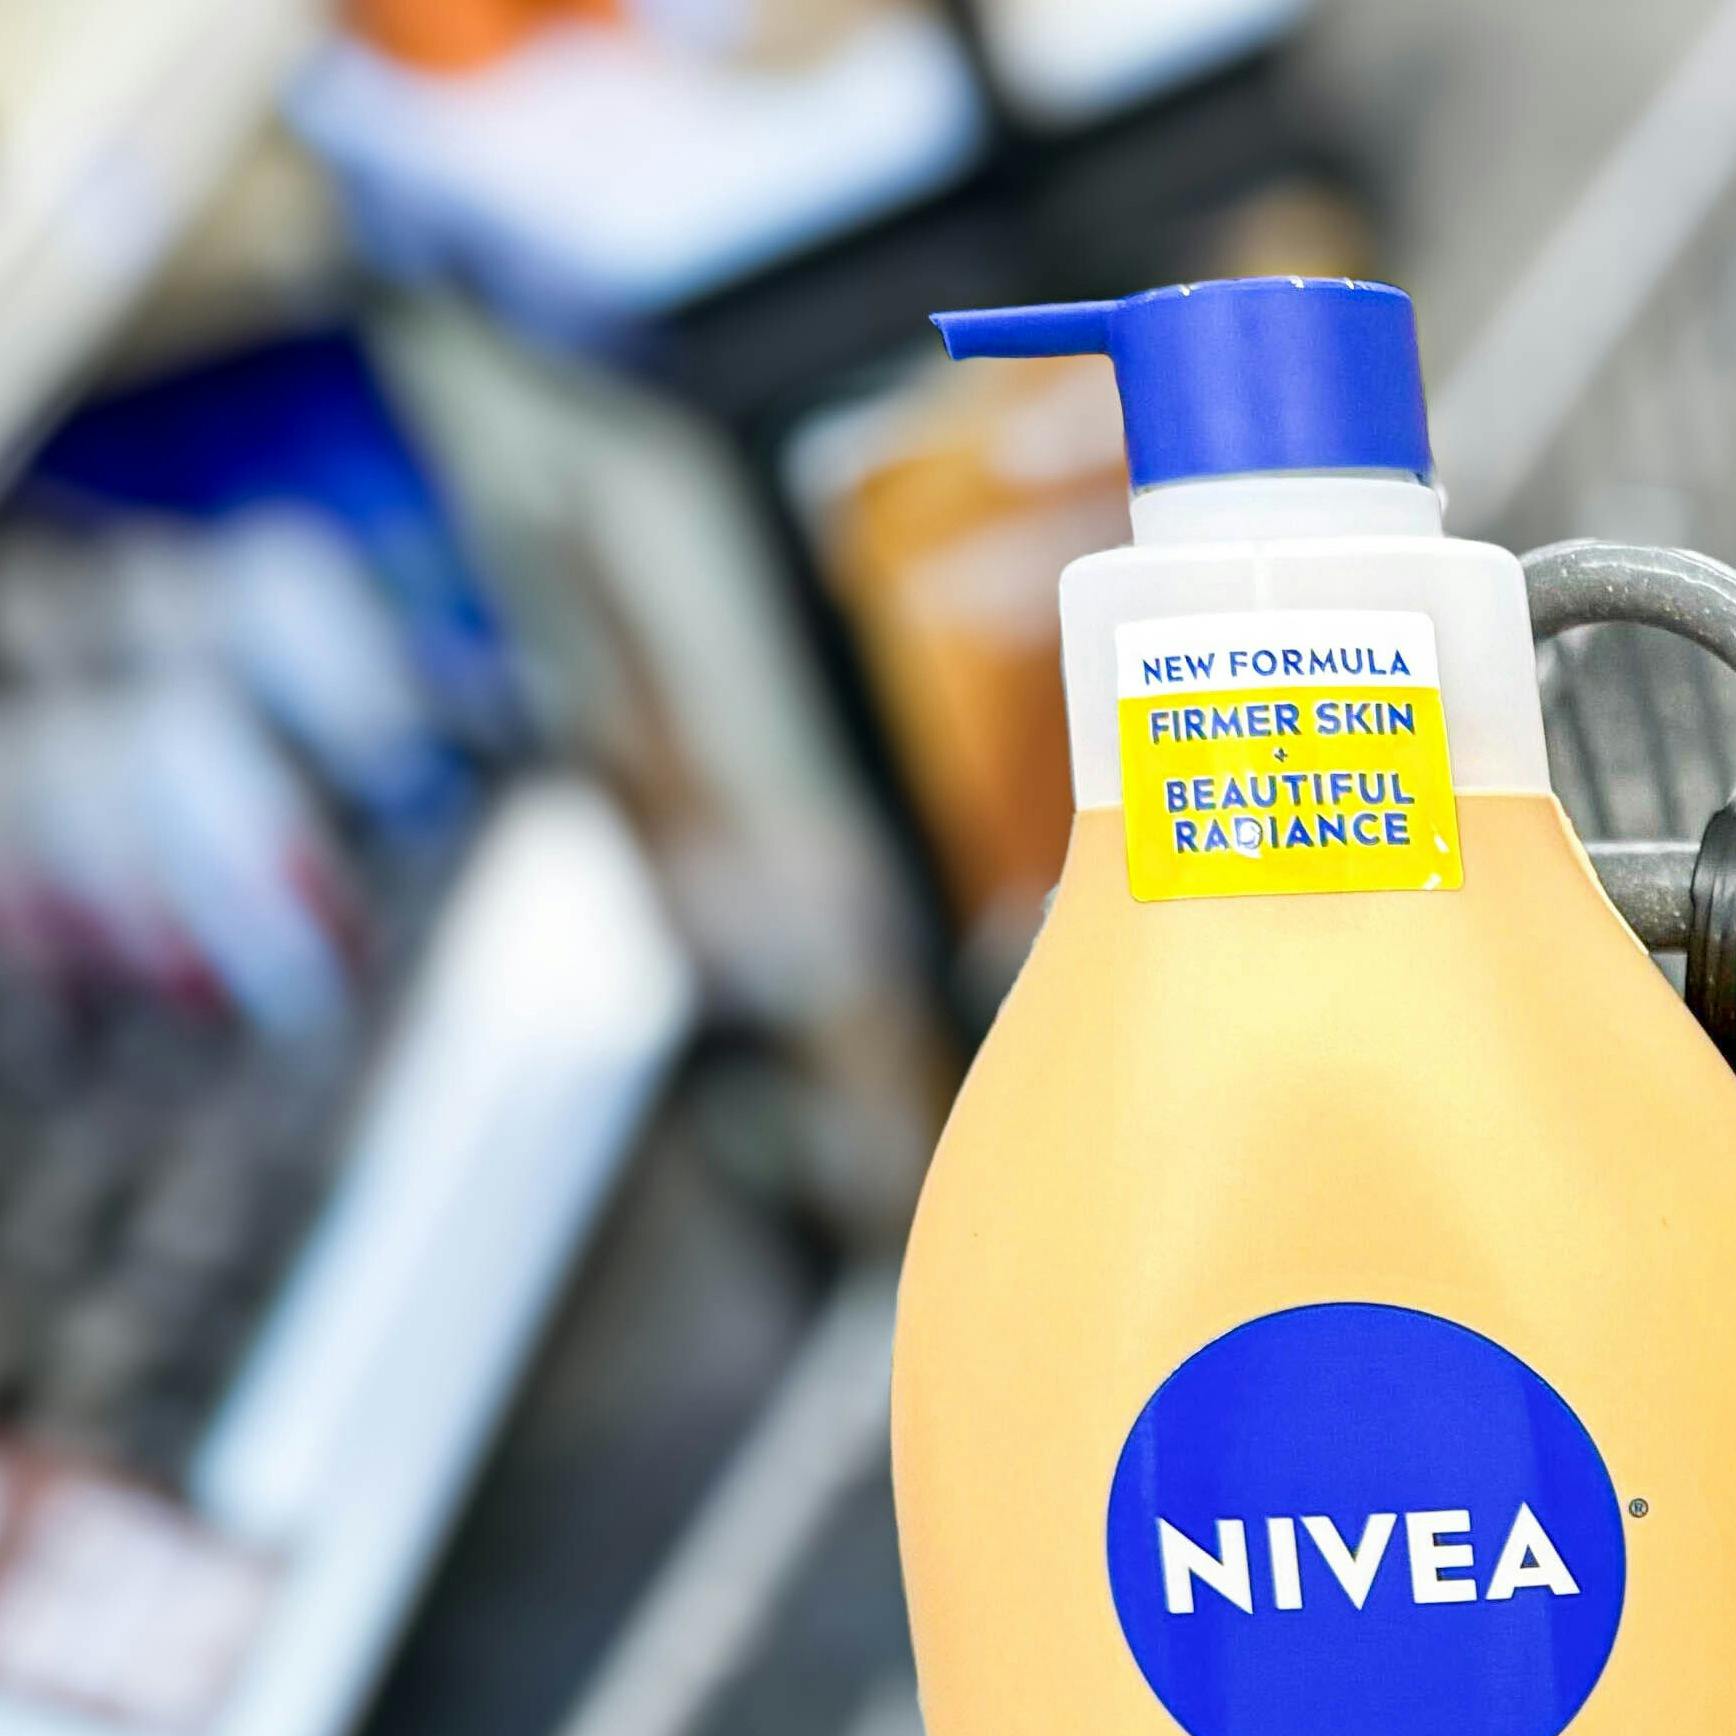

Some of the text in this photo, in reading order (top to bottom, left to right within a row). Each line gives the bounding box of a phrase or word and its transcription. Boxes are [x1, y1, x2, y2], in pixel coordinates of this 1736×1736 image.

[1142, 648, 1411, 686] NEW FORMULA
[1150, 702, 1416, 744] FIRMER SKIN
[1166, 772, 1415, 813] BEAUTIFUL
[1175, 812, 1411, 853] RADIANCE
[1156, 1501, 1581, 1616] NIVEA
